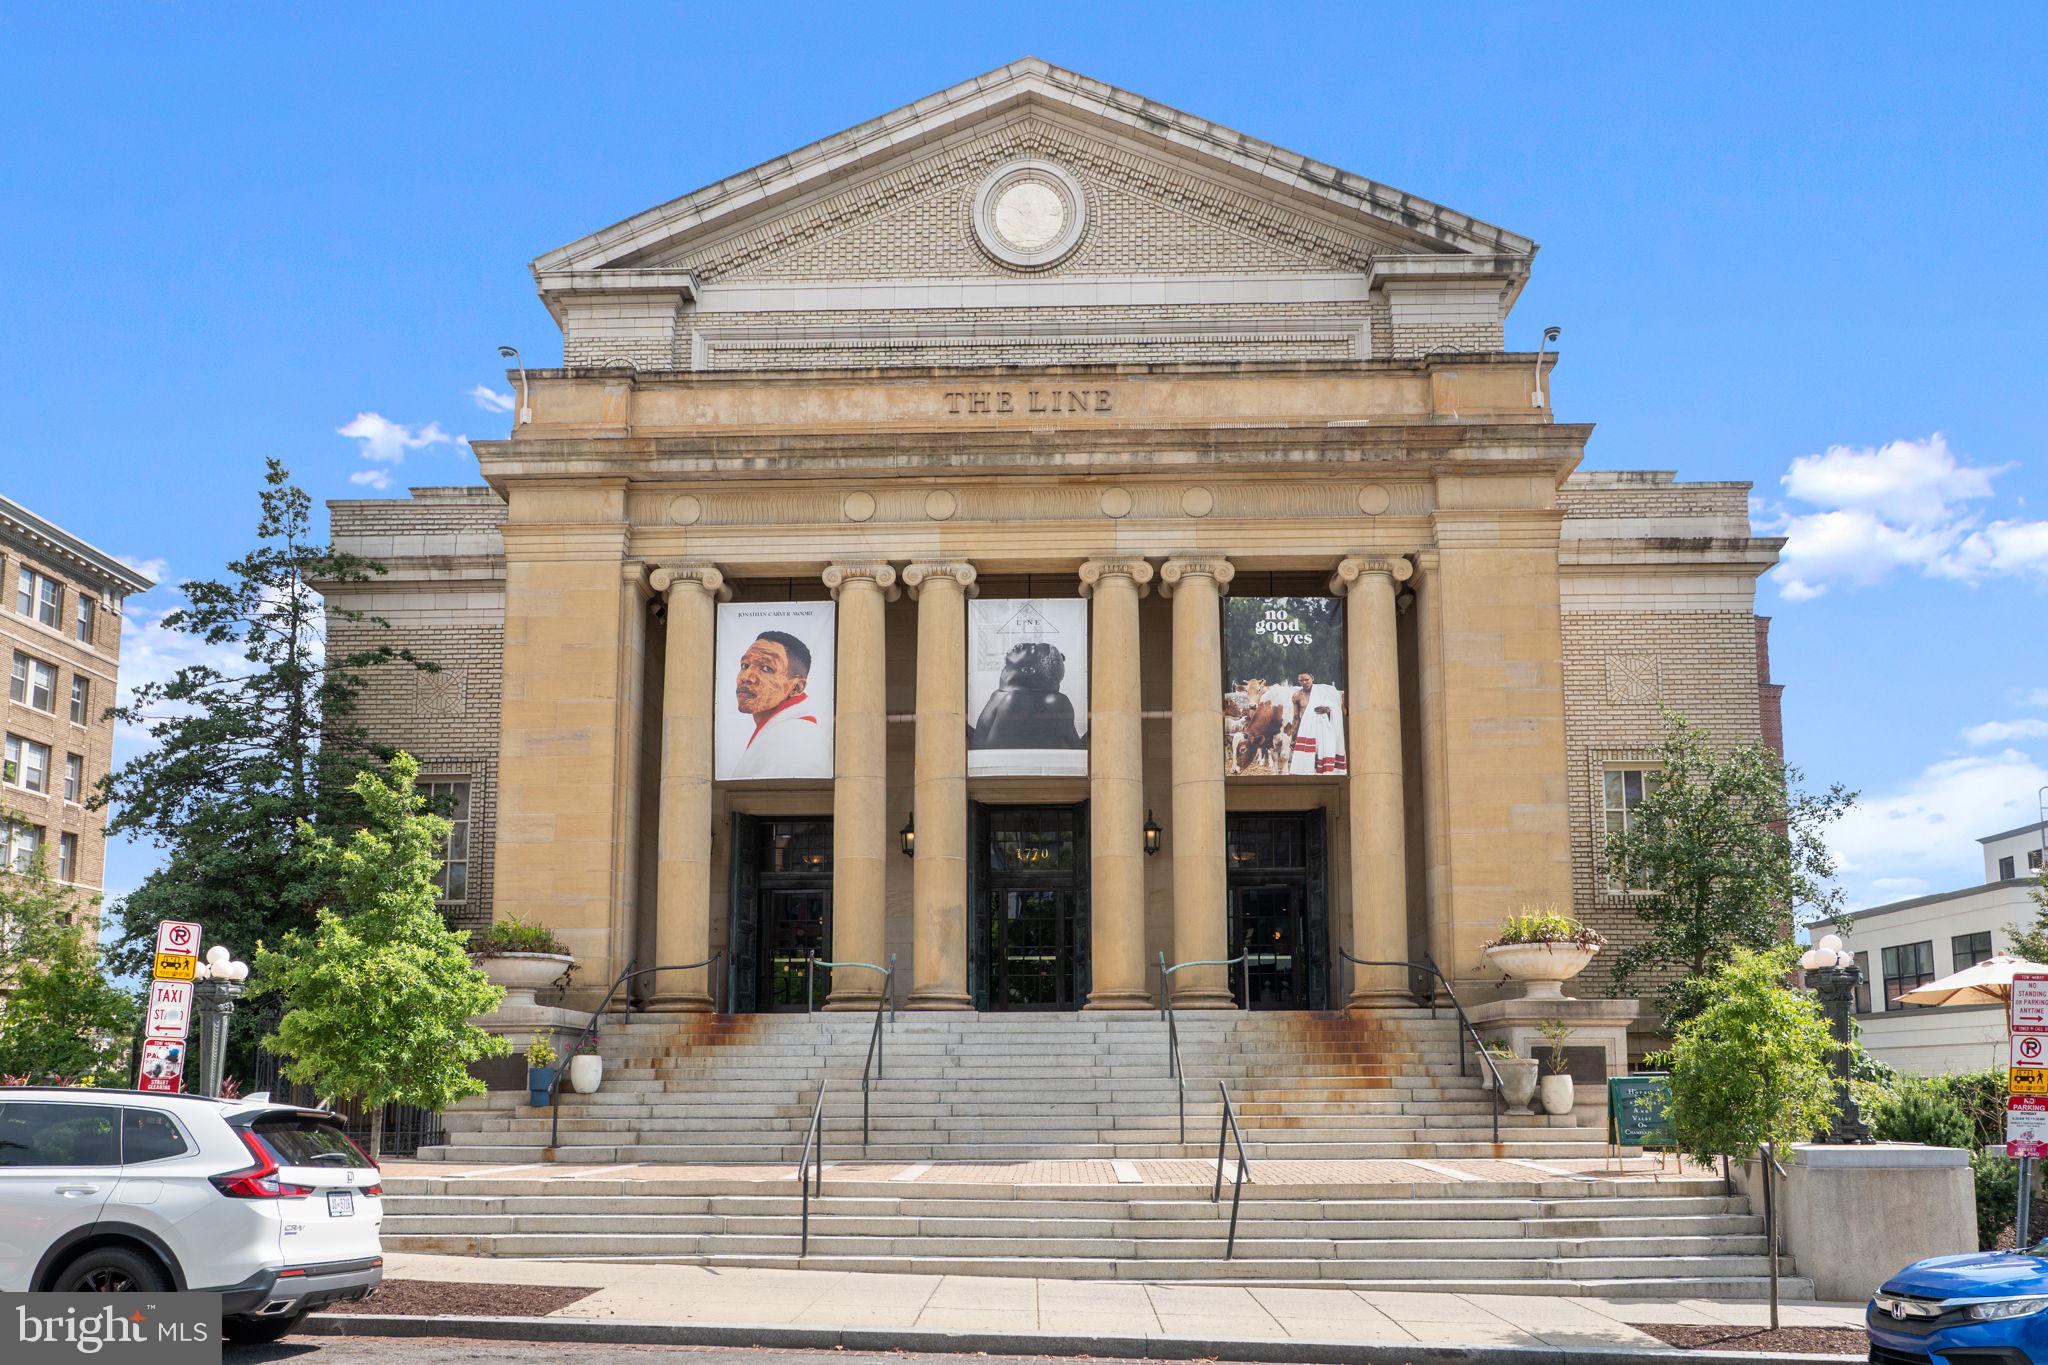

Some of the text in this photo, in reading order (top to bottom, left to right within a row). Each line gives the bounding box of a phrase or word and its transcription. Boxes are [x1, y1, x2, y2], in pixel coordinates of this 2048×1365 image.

[945, 390, 1113, 413] THE LINE
[1264, 610, 1288, 620] no
[1255, 618, 1300, 635] good
[1272, 631, 1313, 647] byes
[1016, 848, 1049, 861] 1770
[157, 988, 183, 1003] TAXI
